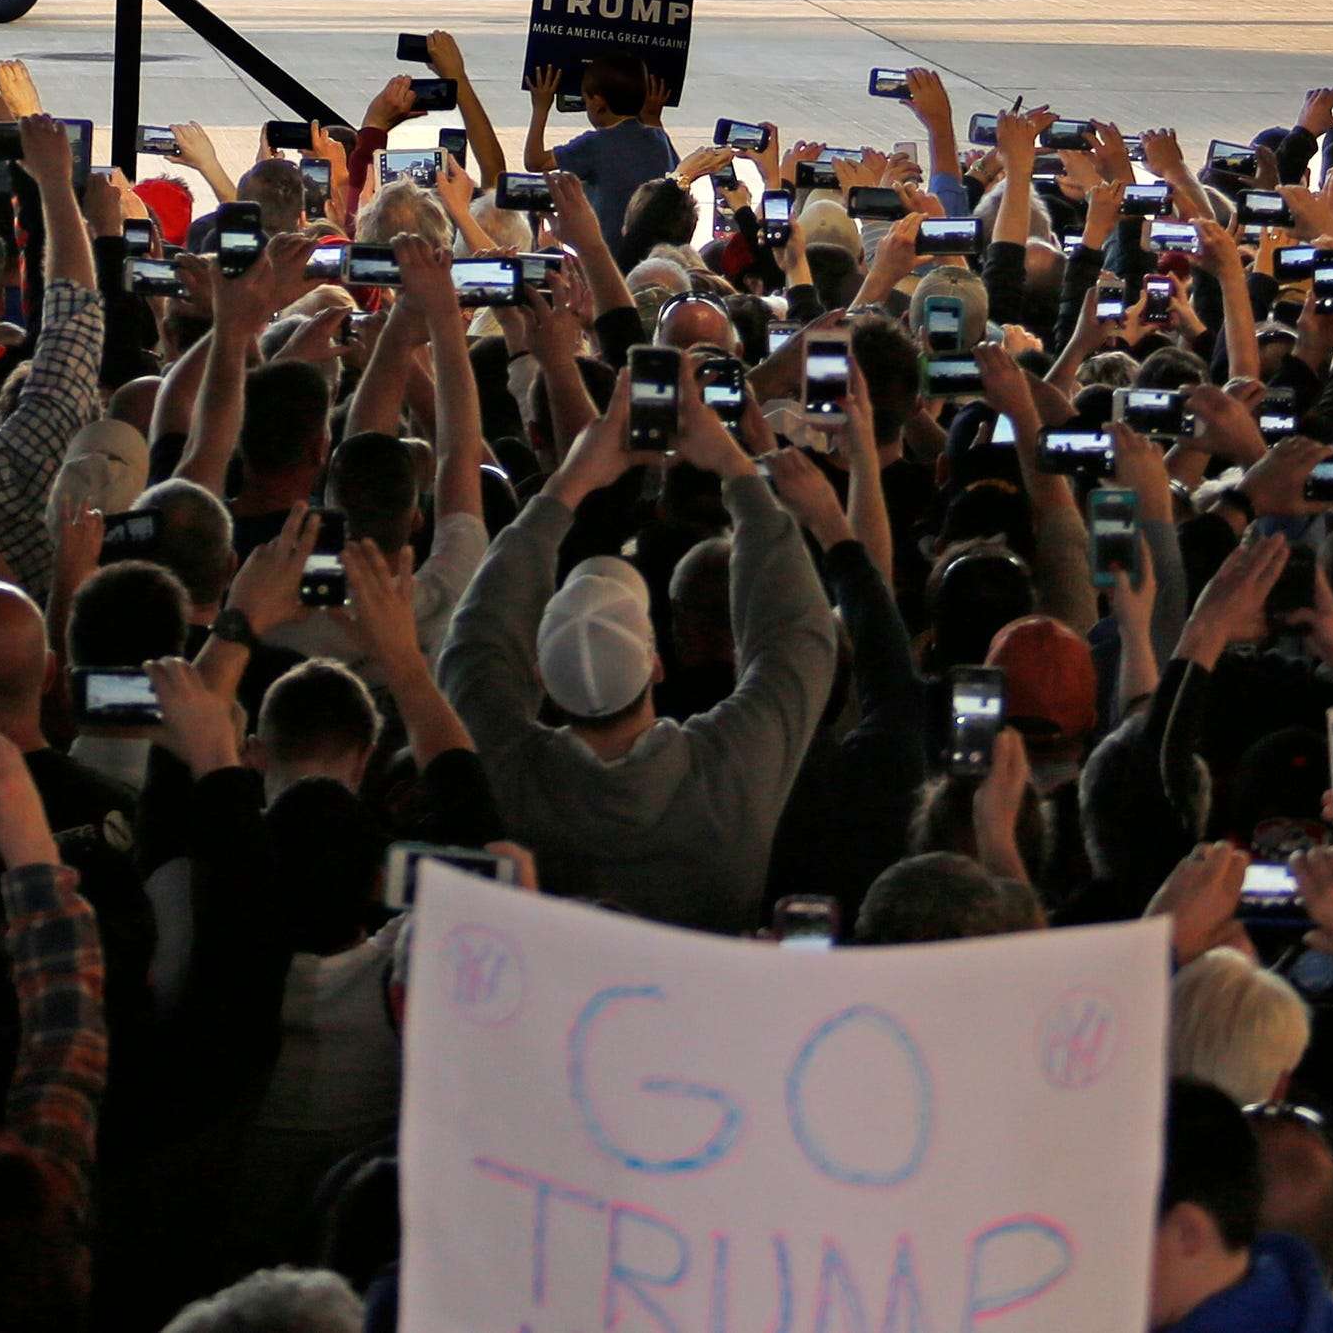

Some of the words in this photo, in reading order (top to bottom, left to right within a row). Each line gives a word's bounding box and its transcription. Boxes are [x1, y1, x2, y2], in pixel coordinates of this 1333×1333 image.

[532, 23, 563, 35] MAKE
[566, 27, 614, 41] AMERICA
[618, 32, 650, 45] GREAT
[652, 37, 687, 50] AGAIN!
[567, 983, 933, 1188] GO
[473, 1156, 1076, 1333] TRUMP
